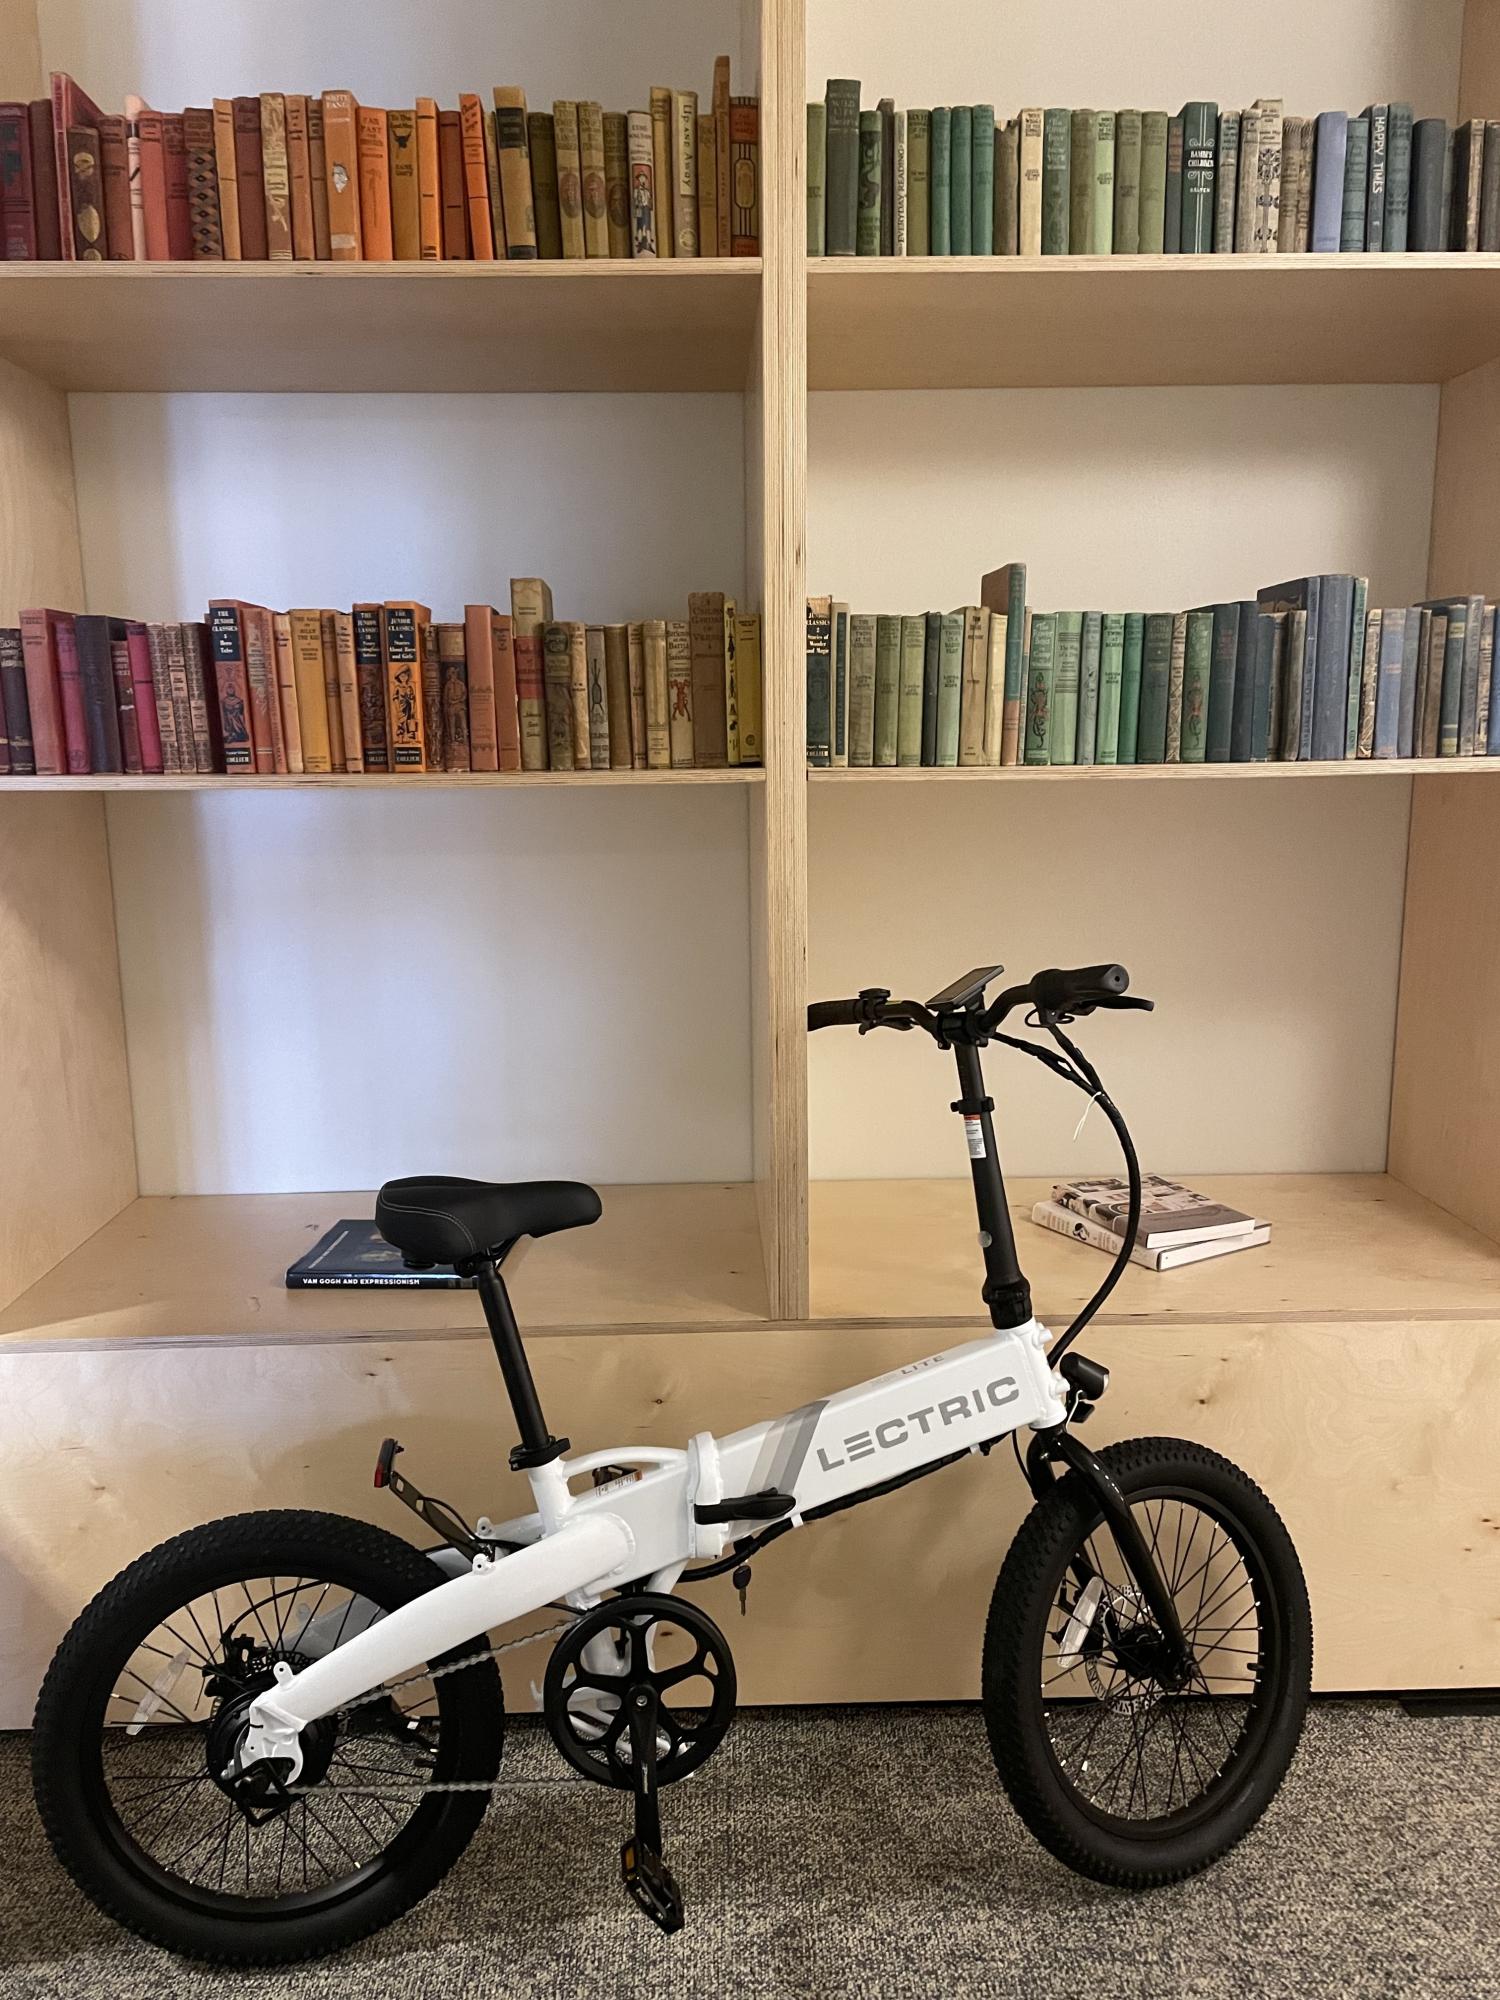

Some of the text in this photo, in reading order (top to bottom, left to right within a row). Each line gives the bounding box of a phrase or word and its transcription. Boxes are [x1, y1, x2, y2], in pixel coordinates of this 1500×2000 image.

[683, 103, 692, 123] Up
[683, 153, 693, 187] Away
[1187, 159, 1214, 168] CHILDREN
[1373, 116, 1384, 193] HAPPY TIMES
[897, 147, 905, 244] EVERYDAY READING
[901, 1355, 944, 1375] LITE
[816, 1375, 1020, 1472] LECTRIC
